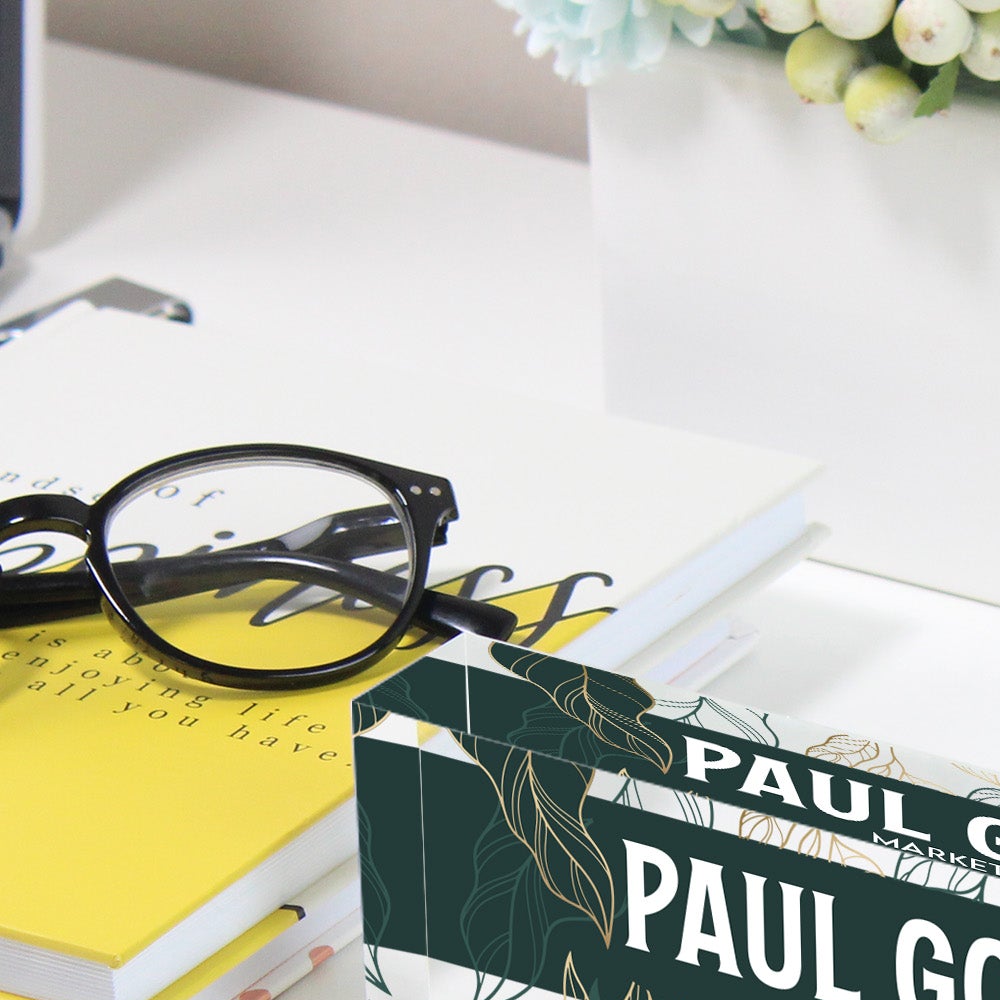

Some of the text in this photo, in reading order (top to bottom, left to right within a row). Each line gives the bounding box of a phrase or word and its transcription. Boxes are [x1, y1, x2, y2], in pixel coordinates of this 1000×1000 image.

[155, 485, 225, 508] of
[27, 629, 67, 649] is
[1, 650, 326, 734] enjoying life
[27, 679, 352, 767] all you have.
[682, 734, 931, 842] PAUL
